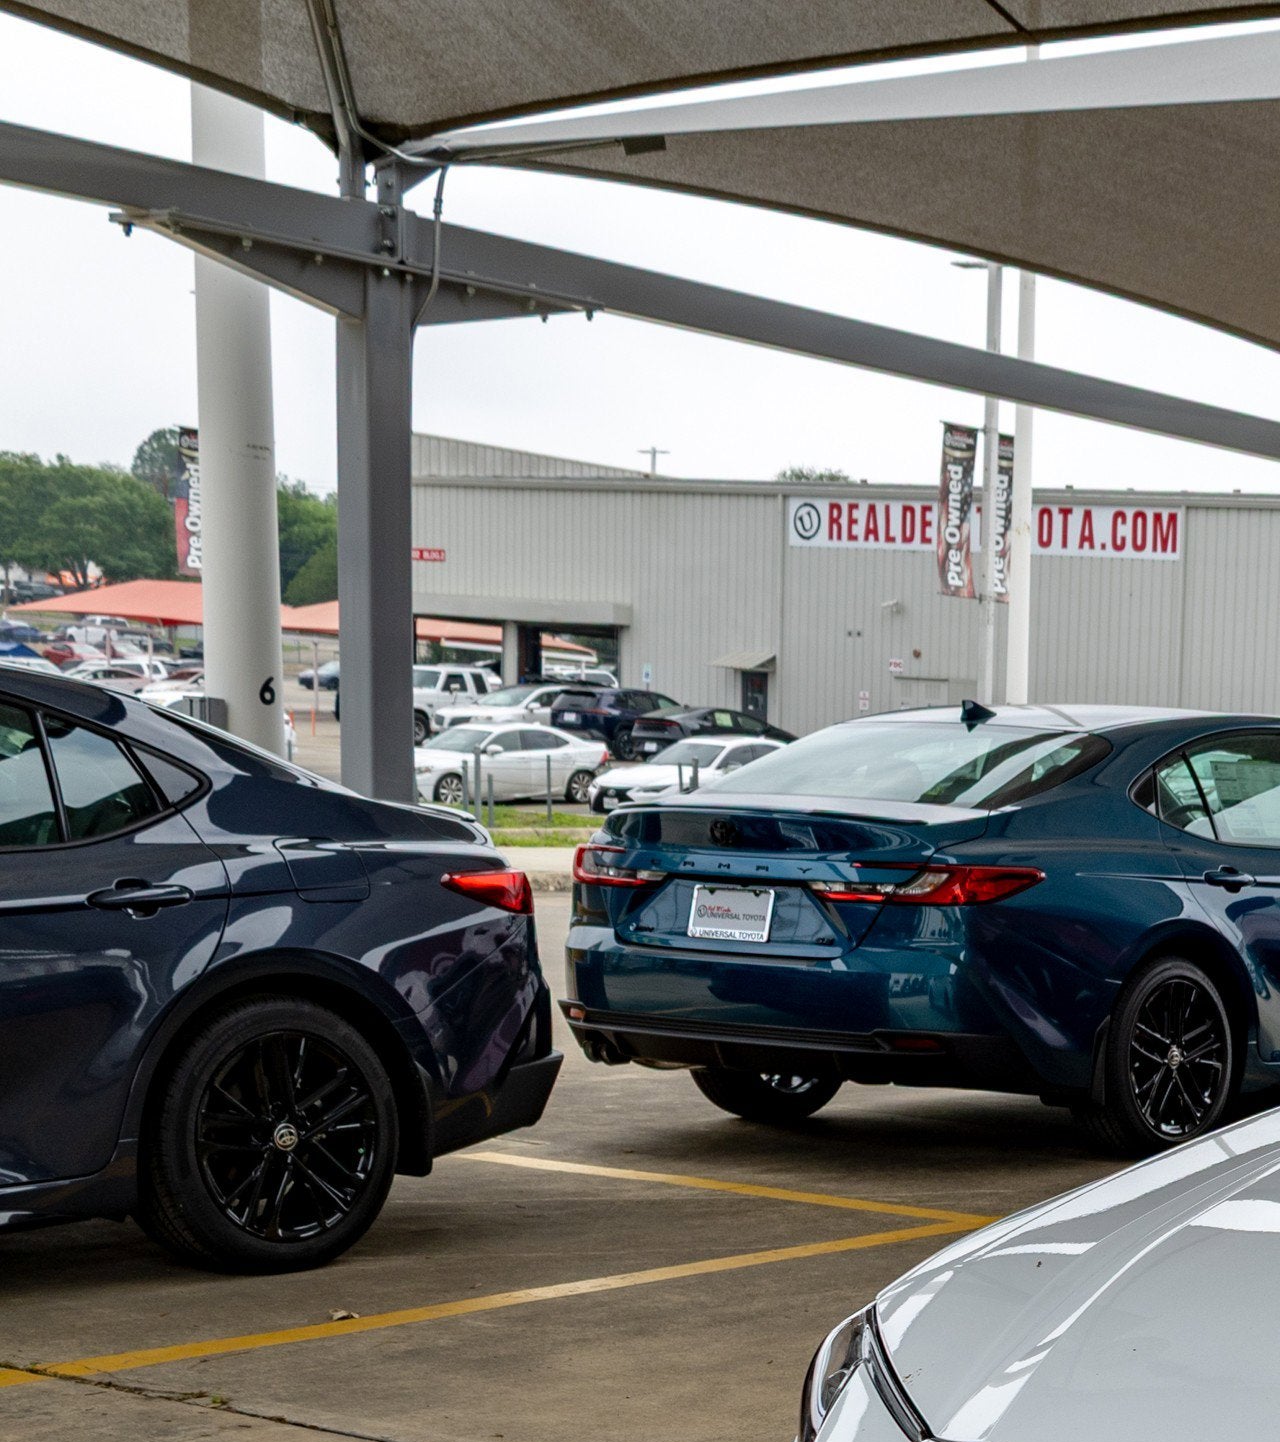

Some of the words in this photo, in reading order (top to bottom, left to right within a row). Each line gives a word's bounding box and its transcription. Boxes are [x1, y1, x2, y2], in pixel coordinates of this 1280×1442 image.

[944, 463, 963, 545] Owned
[827, 502, 1178, 553] REALDEOTA.COM
[947, 549, 963, 587] Pre
[259, 676, 276, 706] 6
[706, 912, 741, 920] UNIVERSAL
[742, 914, 767, 922] TOYOTA
[699, 930, 737, 938] UNIVERSAL
[738, 933, 764, 941] TOYOTA
